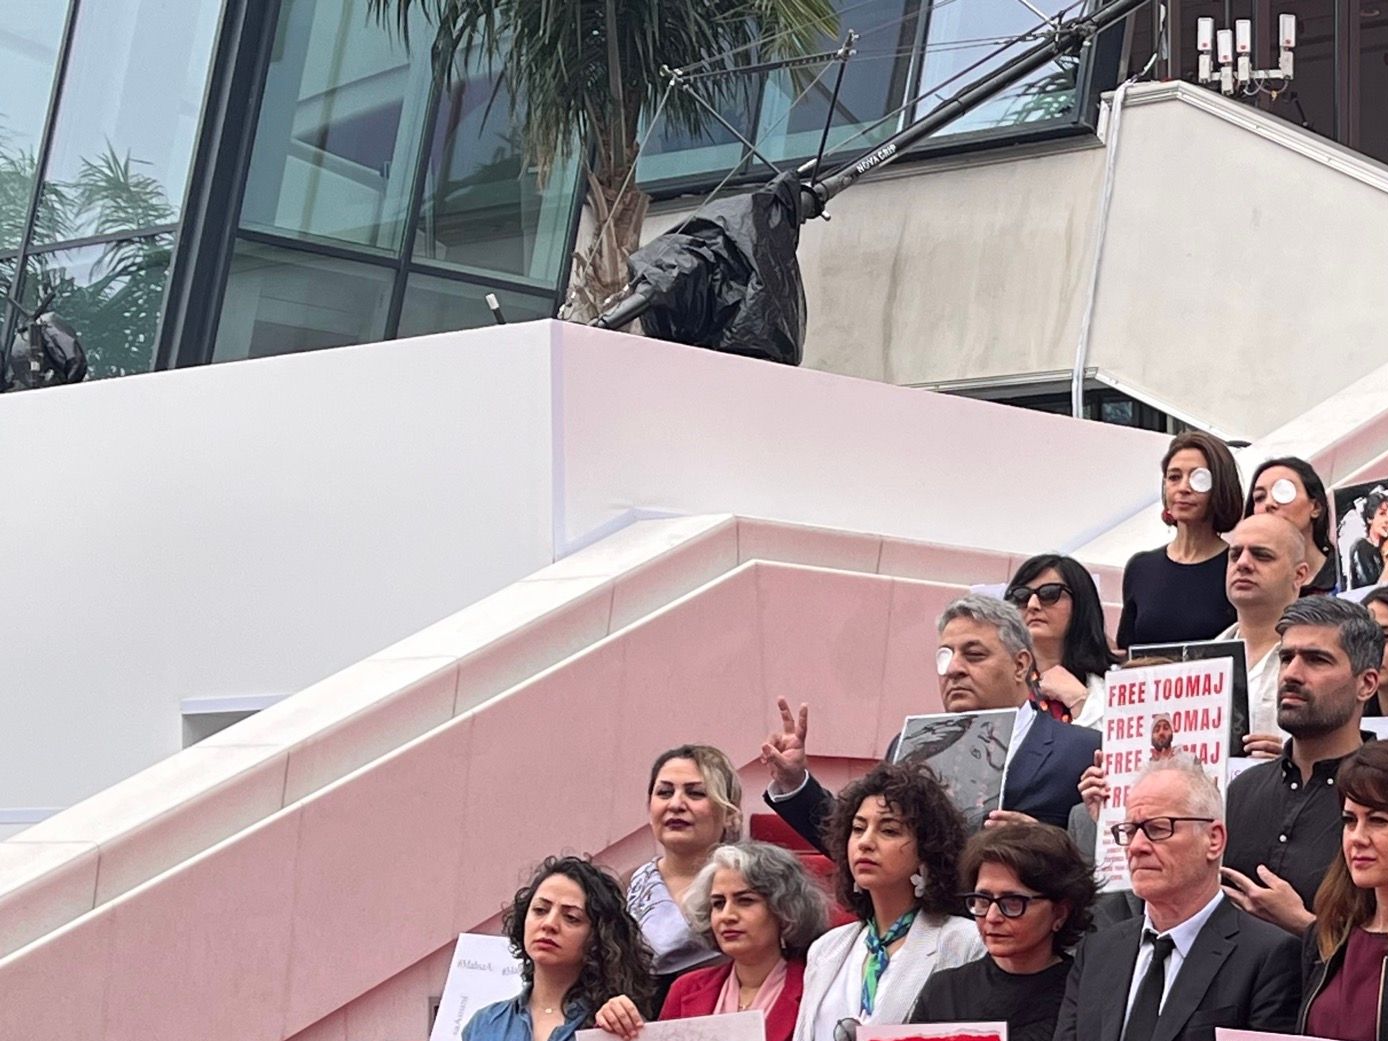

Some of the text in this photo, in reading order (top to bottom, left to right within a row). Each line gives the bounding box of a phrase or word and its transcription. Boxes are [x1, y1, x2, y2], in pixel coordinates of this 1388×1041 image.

[1108, 672, 1224, 707] FREE TOOMAJ
[1106, 706, 1222, 742] FREE OMAJ
[1104, 750, 1143, 777] FREE
